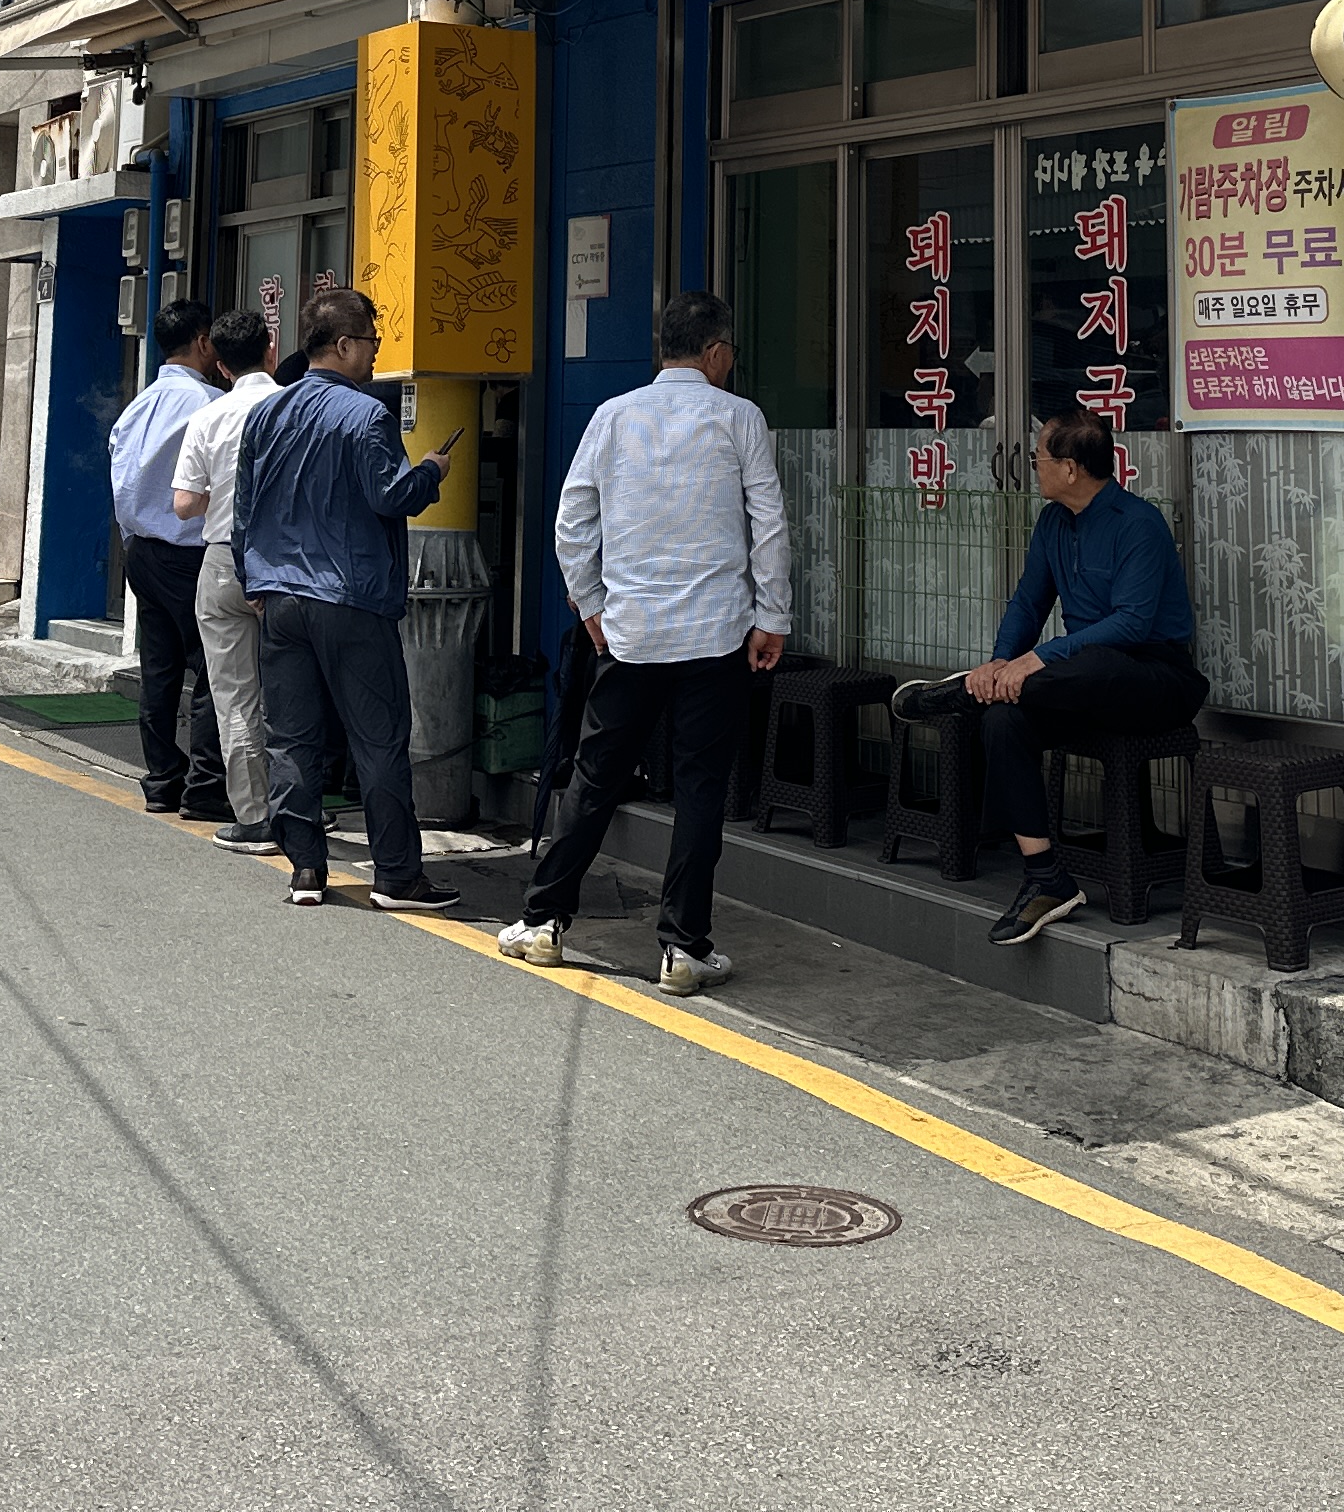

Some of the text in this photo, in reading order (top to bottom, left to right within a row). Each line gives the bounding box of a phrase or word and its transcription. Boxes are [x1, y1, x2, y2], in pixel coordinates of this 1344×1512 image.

[1231, 110, 1291, 144] 알림
[1185, 226, 1343, 278] 30분 무료
[1197, 293, 1320, 320] 매주 일요일 휴무
[905, 210, 956, 511] 돼지국밥
[1193, 376, 1250, 401] 무료주차
[1253, 375, 1281, 401] 하지
